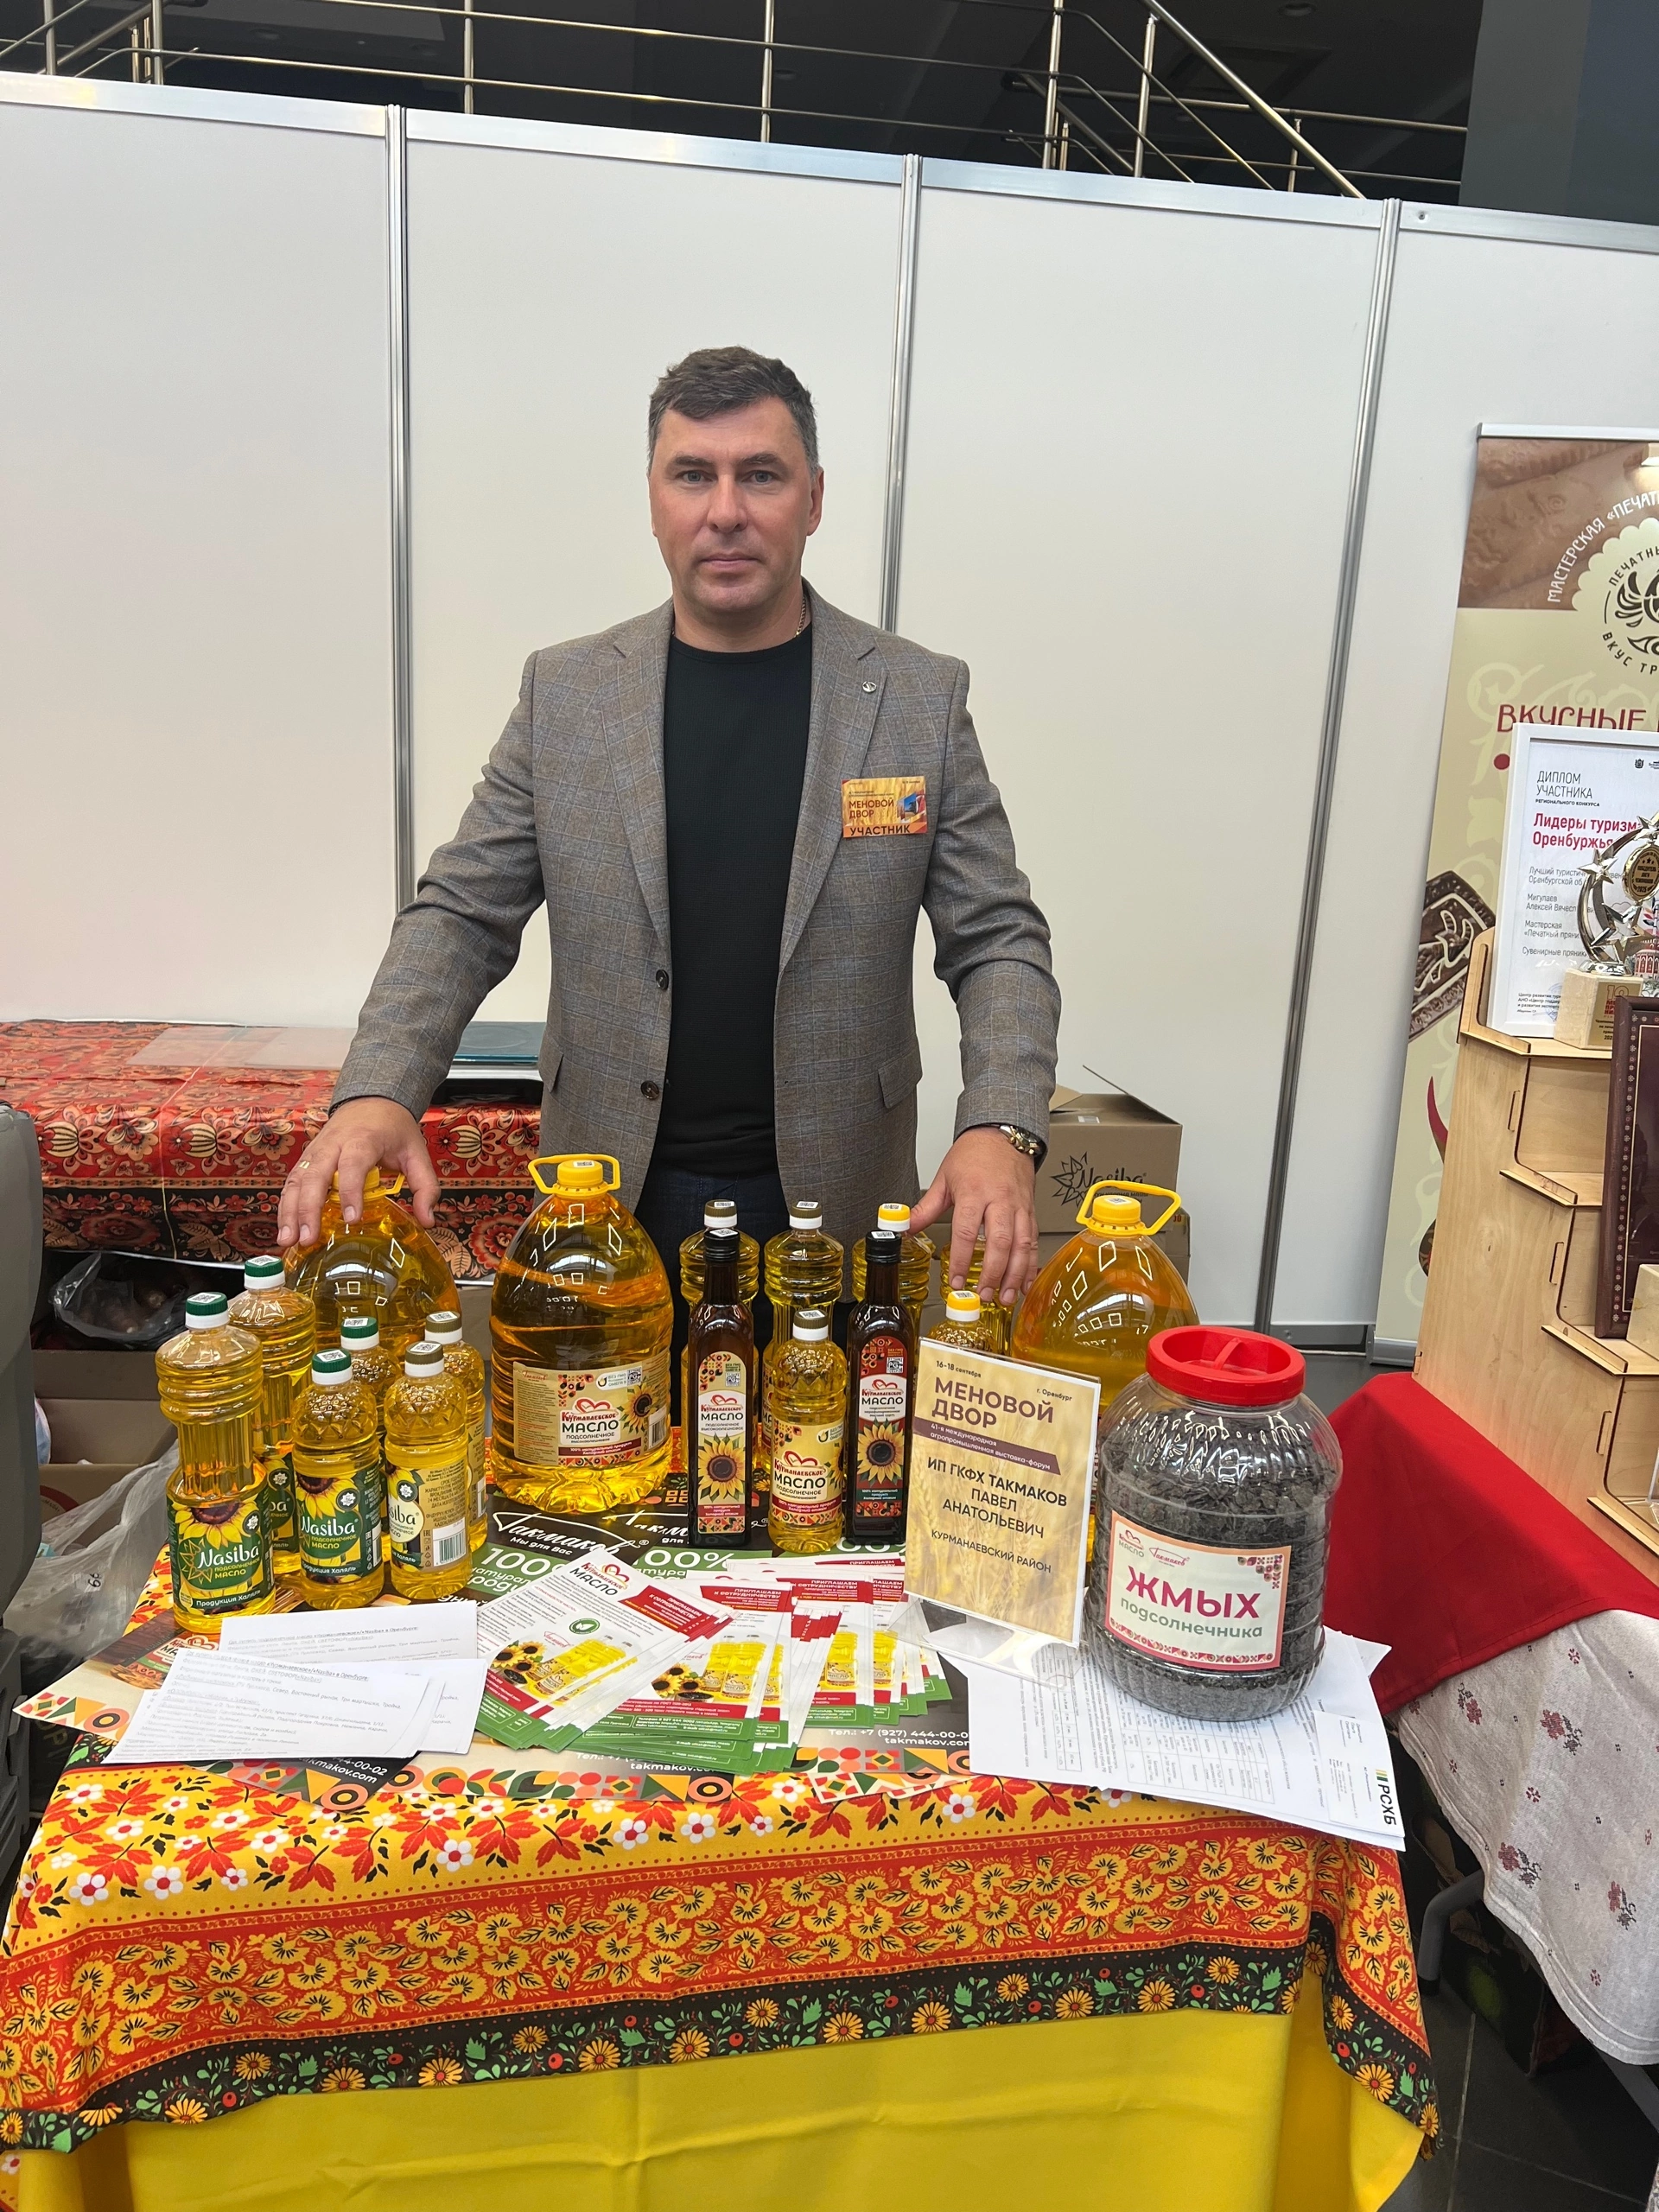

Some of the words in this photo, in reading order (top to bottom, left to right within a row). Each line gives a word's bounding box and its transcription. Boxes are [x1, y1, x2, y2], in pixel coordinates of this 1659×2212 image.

[1548, 518, 1605, 603] МАСТЕРСКАЯ
[1603, 632, 1632, 666] ВКУС
[1536, 771, 1581, 785] ДИПЛОМ
[1536, 785, 1593, 798] УЧАСТНИКА
[849, 798, 894, 809] МЕНОВОЙ
[849, 810, 874, 819] ДВОР
[1534, 813, 1586, 832] Лидеры
[850, 825, 911, 836] УЧАСТНИК
[1529, 867, 1554, 876] Лучший
[1529, 876, 1573, 886] Оренбургской
[1526, 902, 1554, 911] Алексей
[1525, 920, 1562, 930] Мастерская
[1522, 947, 1561, 956] Сувенирные
[936, 1360, 955, 1372] 16-18
[955, 1367, 982, 1378] сентября
[935, 1376, 1054, 1424] МЕНОВОЙ
[1042, 1388, 1072, 1402] Оренбург
[701, 1412, 744, 1421] МАСЛО
[931, 1398, 997, 1428] ДВОР
[562, 1420, 619, 1433] МАСЛО
[931, 1423, 944, 1432] 41-я
[945, 1426, 997, 1446] международная
[931, 1432, 995, 1455] агропромышленная
[995, 1450, 1052, 1471] выставка-форум
[774, 1471, 826, 1489] МАСЛО
[927, 1456, 947, 1473] ИП
[950, 1464, 985, 1484] ГКФХ
[988, 1473, 1068, 1507] ТАКМАКОВ
[970, 1487, 1017, 1512] ПАВЕЛ
[302, 1516, 356, 1536] Nasiba
[942, 1498, 1044, 1538] АНАТОЛЬЕВИЧ
[311, 1534, 357, 1542] ПОДСОЛНЕЧНОЕ
[510, 1536, 527, 1548] Мы
[529, 1541, 550, 1554] для
[197, 1544, 259, 1569] Nasiba
[931, 1529, 1015, 1562] КУРМАНАЕВСКИЙ
[1016, 1554, 1052, 1573] РАЙОН
[1119, 1540, 1145, 1558] МАСЛО
[214, 1558, 260, 1572] ПОДСОЛНЕЧНОЕ
[397, 1554, 416, 1563] Халяль
[214, 1568, 246, 1579] МАСЛО
[569, 1567, 619, 1597] МАСЛО
[196, 1597, 238, 1610] Продукция
[238, 1589, 261, 1602] Халяль
[1125, 1565, 1261, 1619] ЖМЫХ
[1121, 1597, 1262, 1639] подсолнечника
[877, 1729, 907, 1738] (927)
[911, 1730, 969, 1738] 444-00-0
[1378, 1783, 1397, 1826] РСХБ
